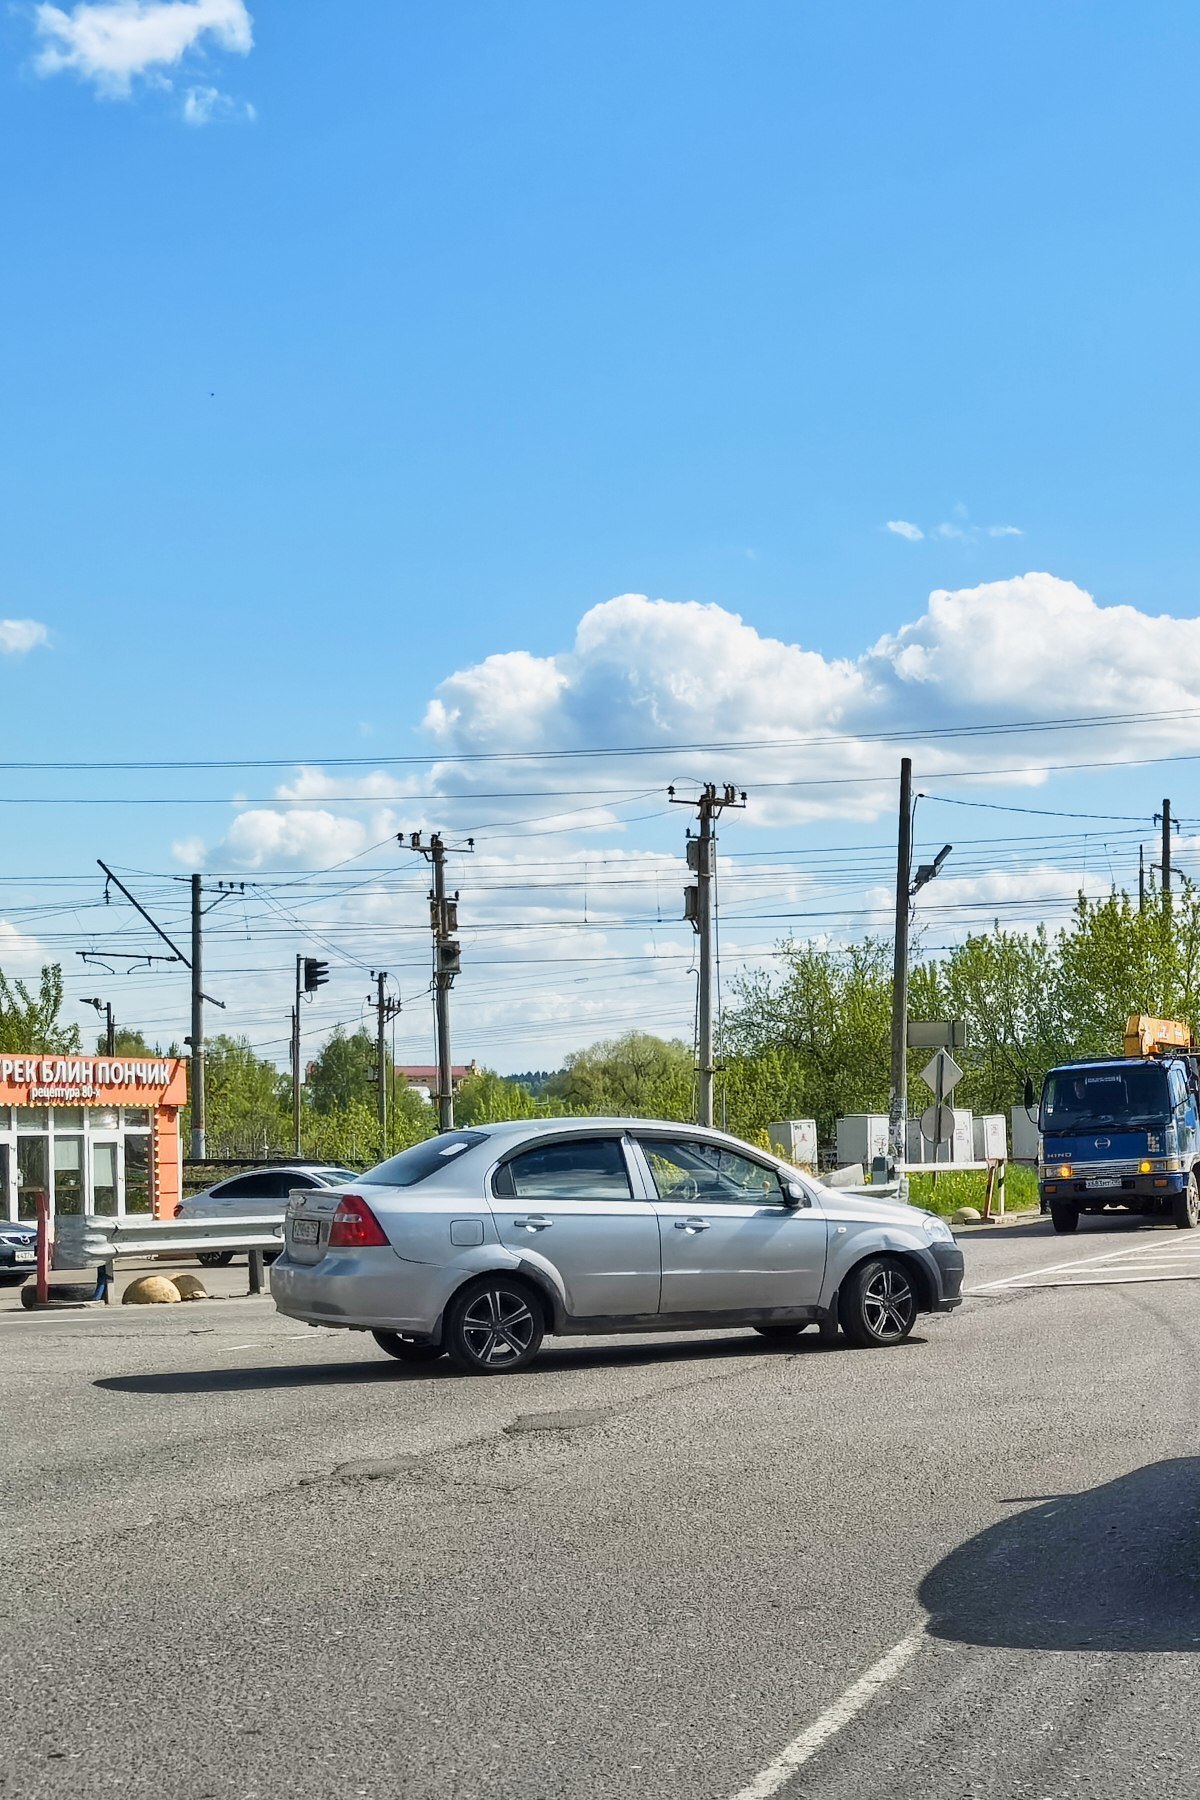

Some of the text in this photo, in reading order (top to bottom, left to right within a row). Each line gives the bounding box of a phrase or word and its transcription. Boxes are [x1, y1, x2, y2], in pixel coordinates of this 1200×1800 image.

[0, 1060, 170, 1085] РЕК БЛИН ПОНЧИК
[32, 1087, 80, 1100] рецептура
